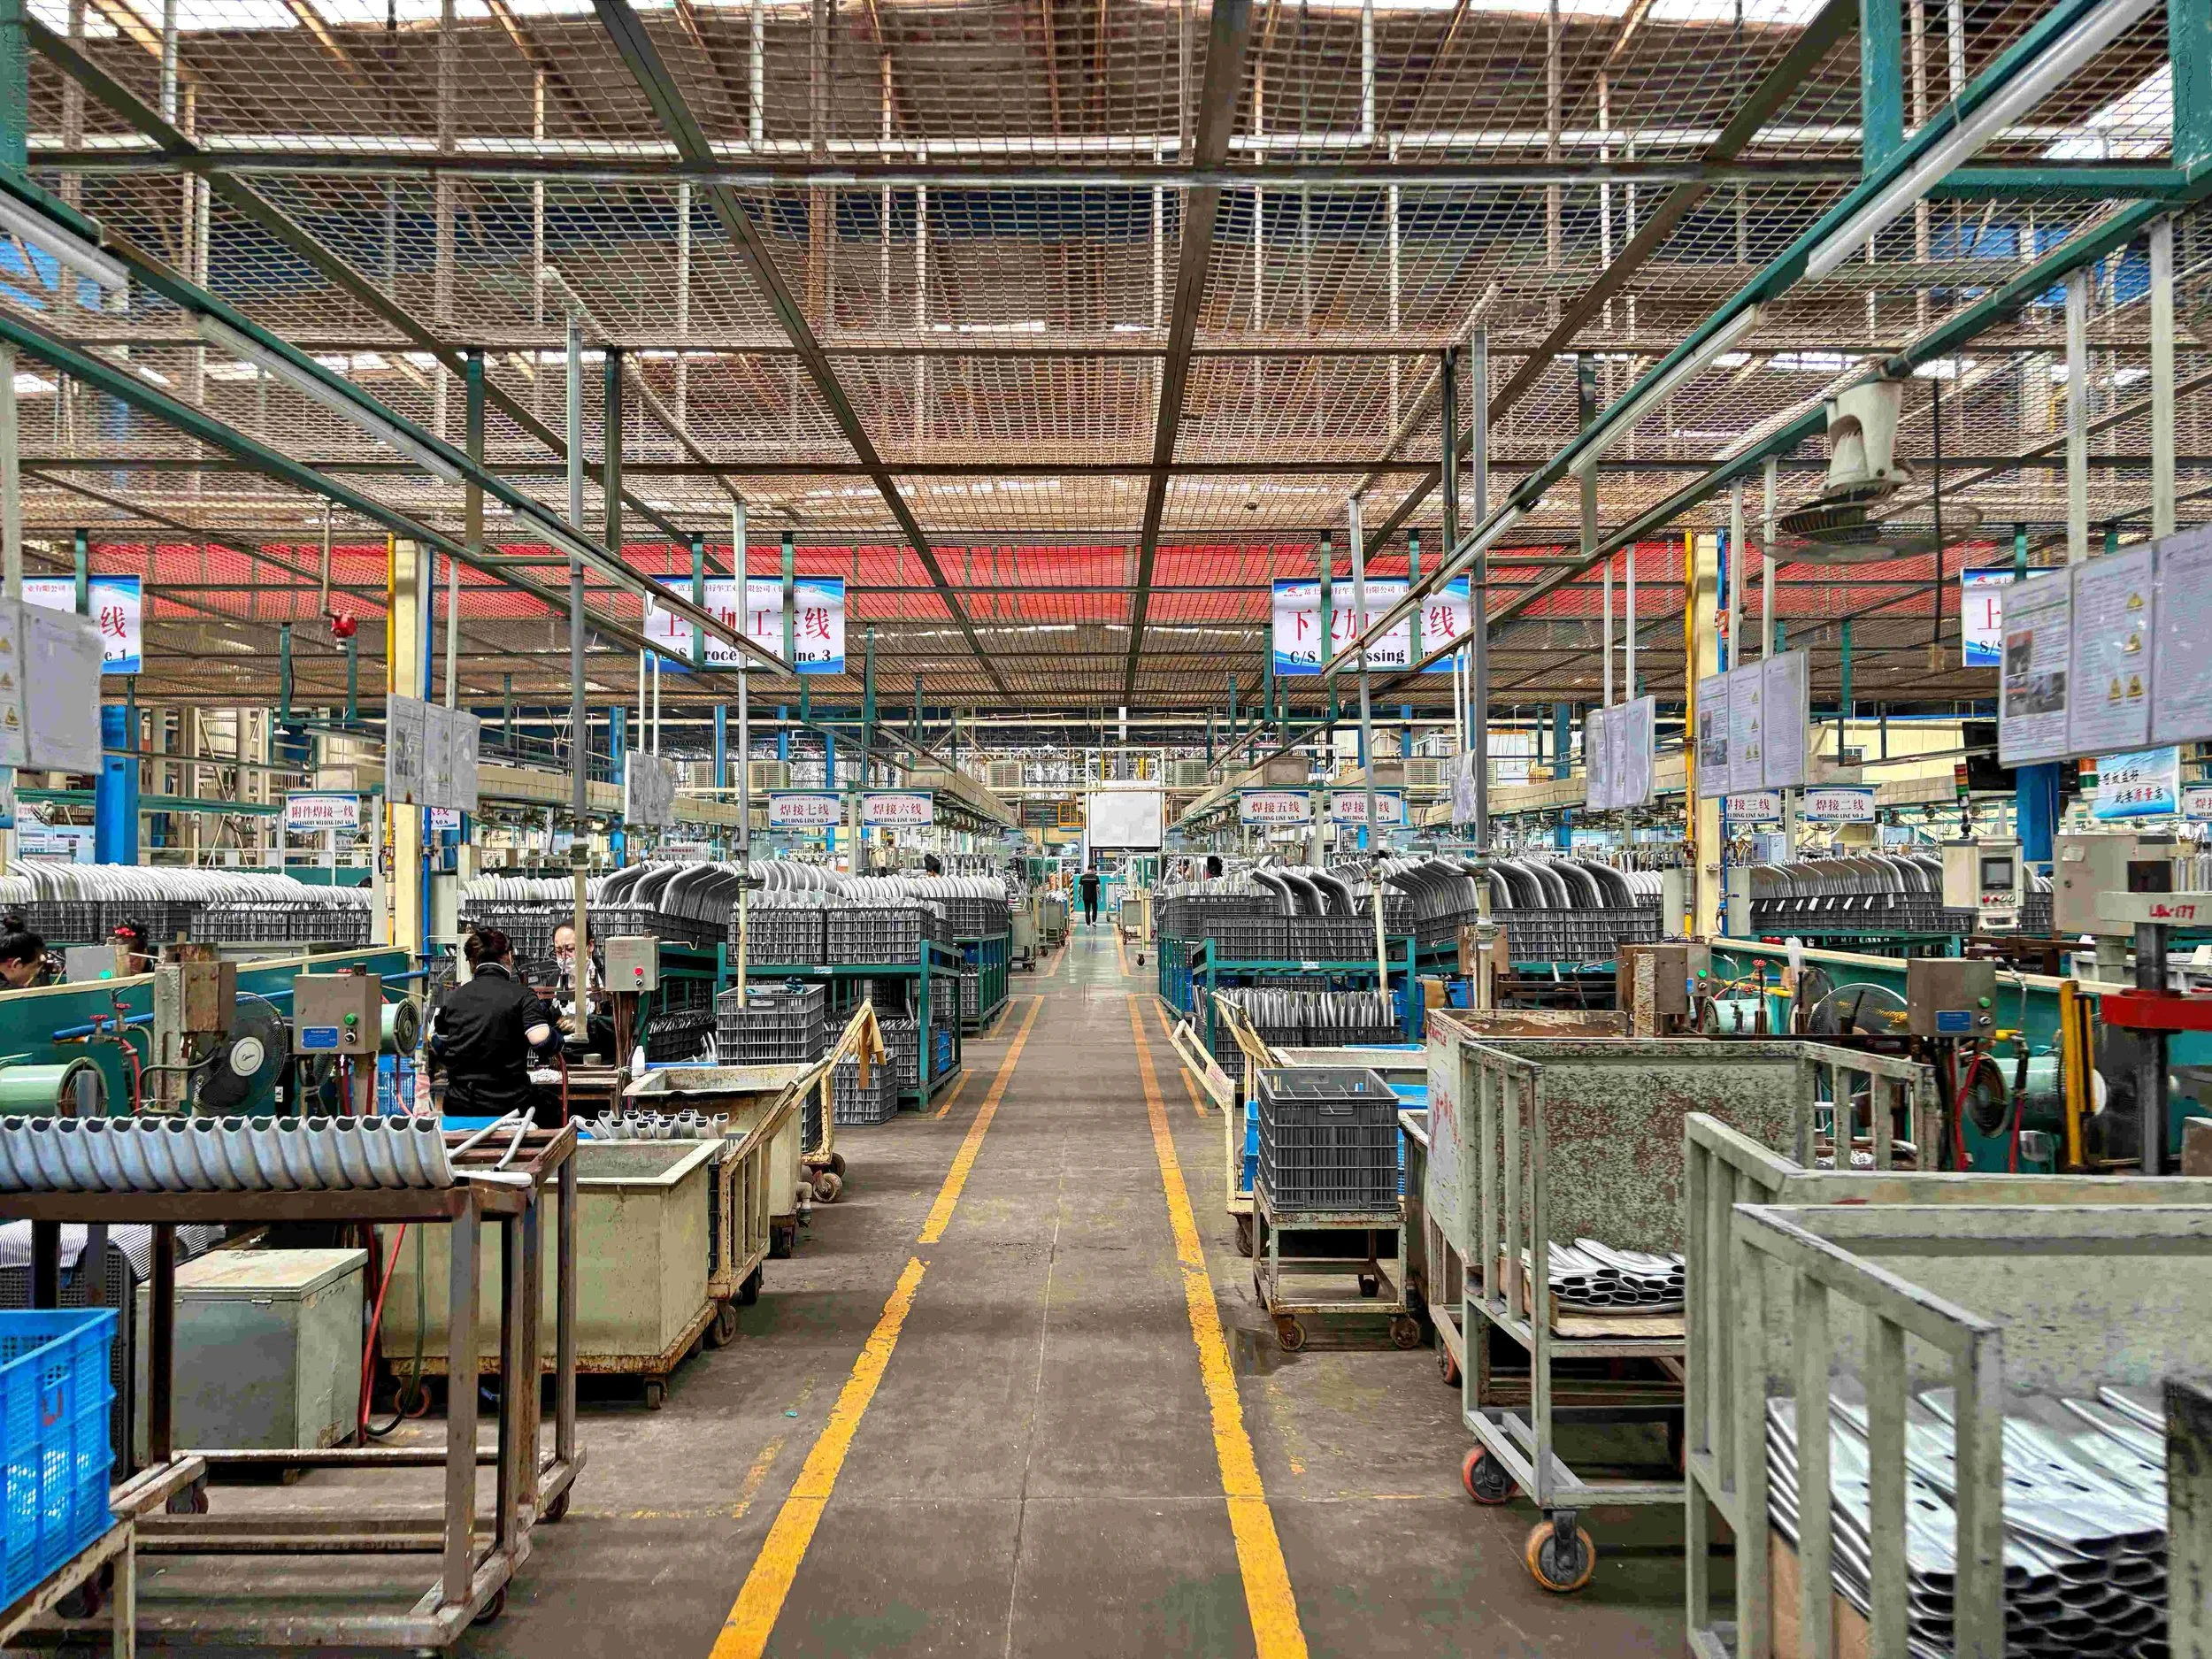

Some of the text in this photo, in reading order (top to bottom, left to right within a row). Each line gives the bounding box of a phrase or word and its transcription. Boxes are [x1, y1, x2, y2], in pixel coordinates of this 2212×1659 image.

[822, 649, 831, 662] 3
[1289, 649, 1317, 664] C/S
[291, 804, 354, 818] 附件焊接一线
[780, 803, 829, 816] 焊接七线
[872, 803, 922, 815] 焊接六线
[1252, 801, 1300, 813] 焊接五线
[1341, 801, 1390, 813] 焊接线
[1816, 799, 1864, 811] 焊接二线
